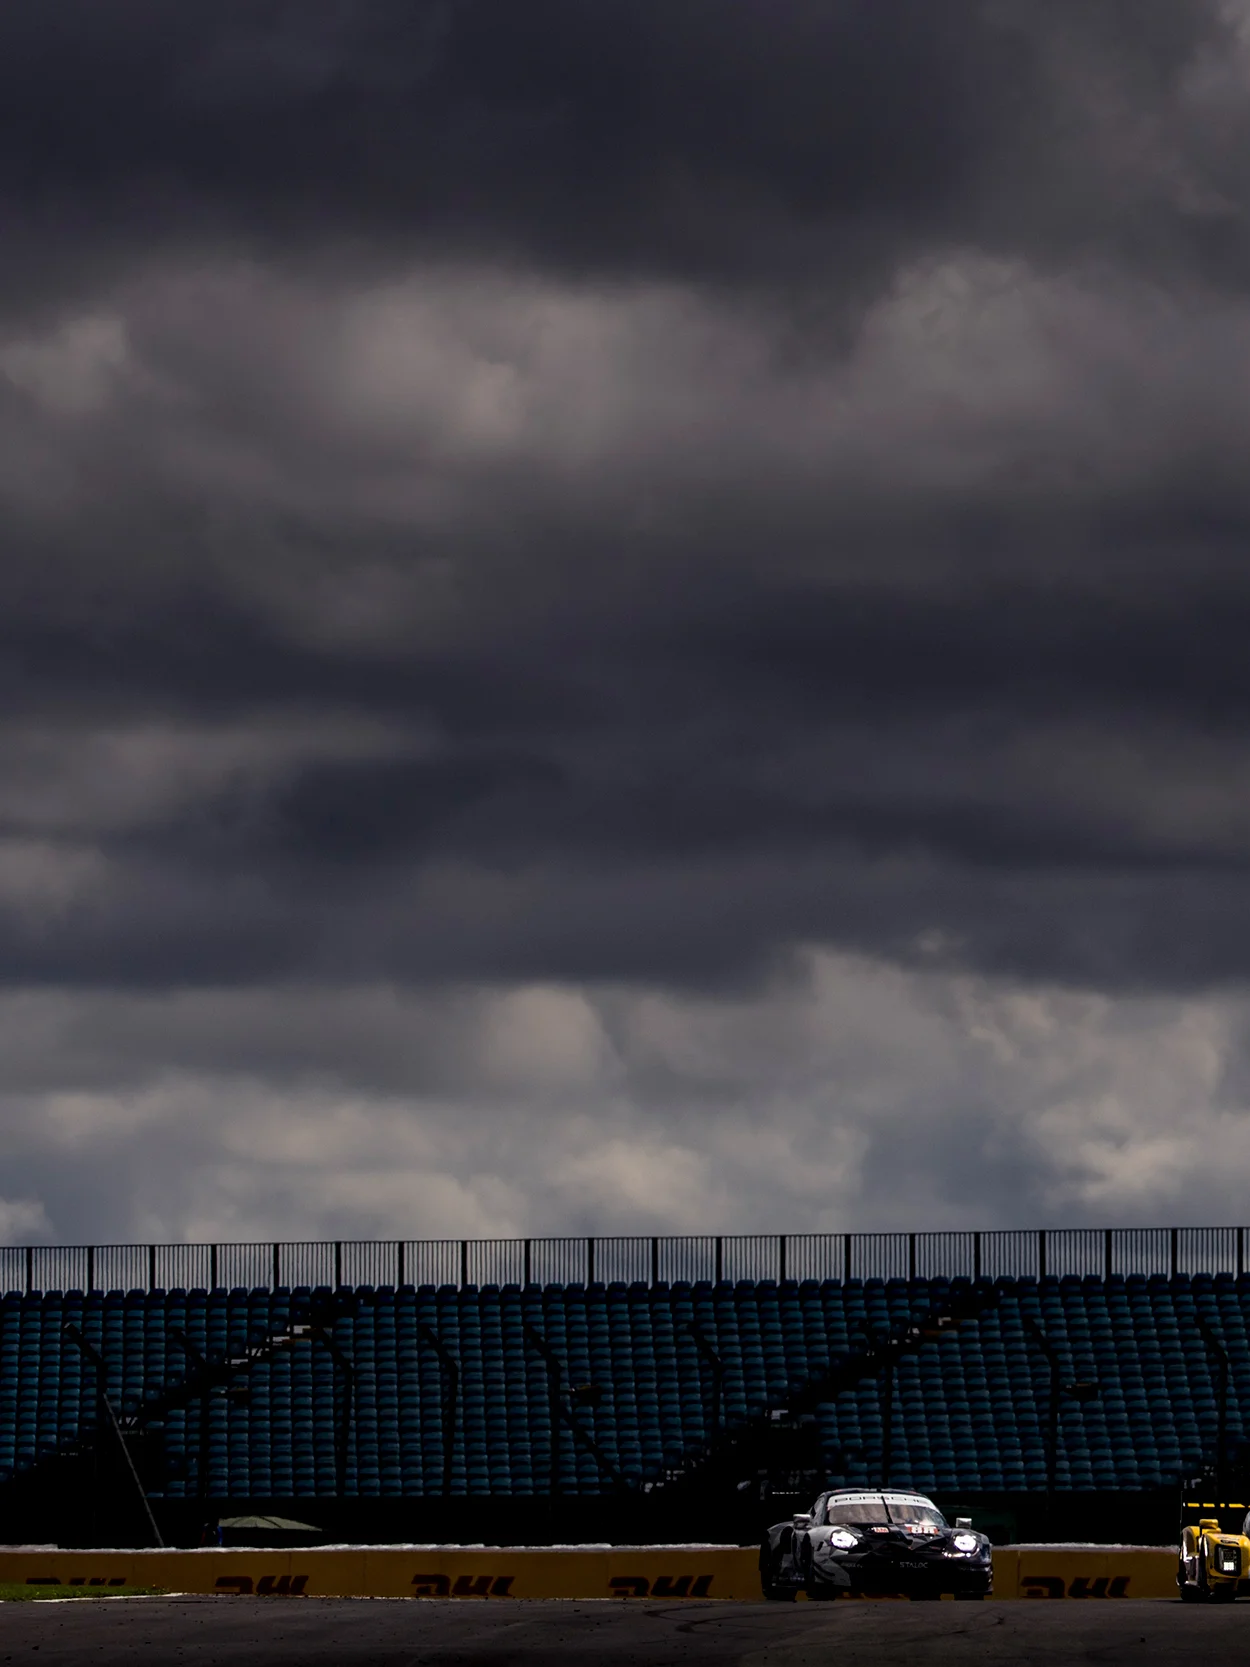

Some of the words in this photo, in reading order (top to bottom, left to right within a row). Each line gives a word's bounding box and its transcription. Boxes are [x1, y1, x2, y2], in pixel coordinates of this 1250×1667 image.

[411, 1574, 515, 1596] DHL
[609, 1575, 714, 1597] DHL
[1020, 1576, 1130, 1598] DHL
